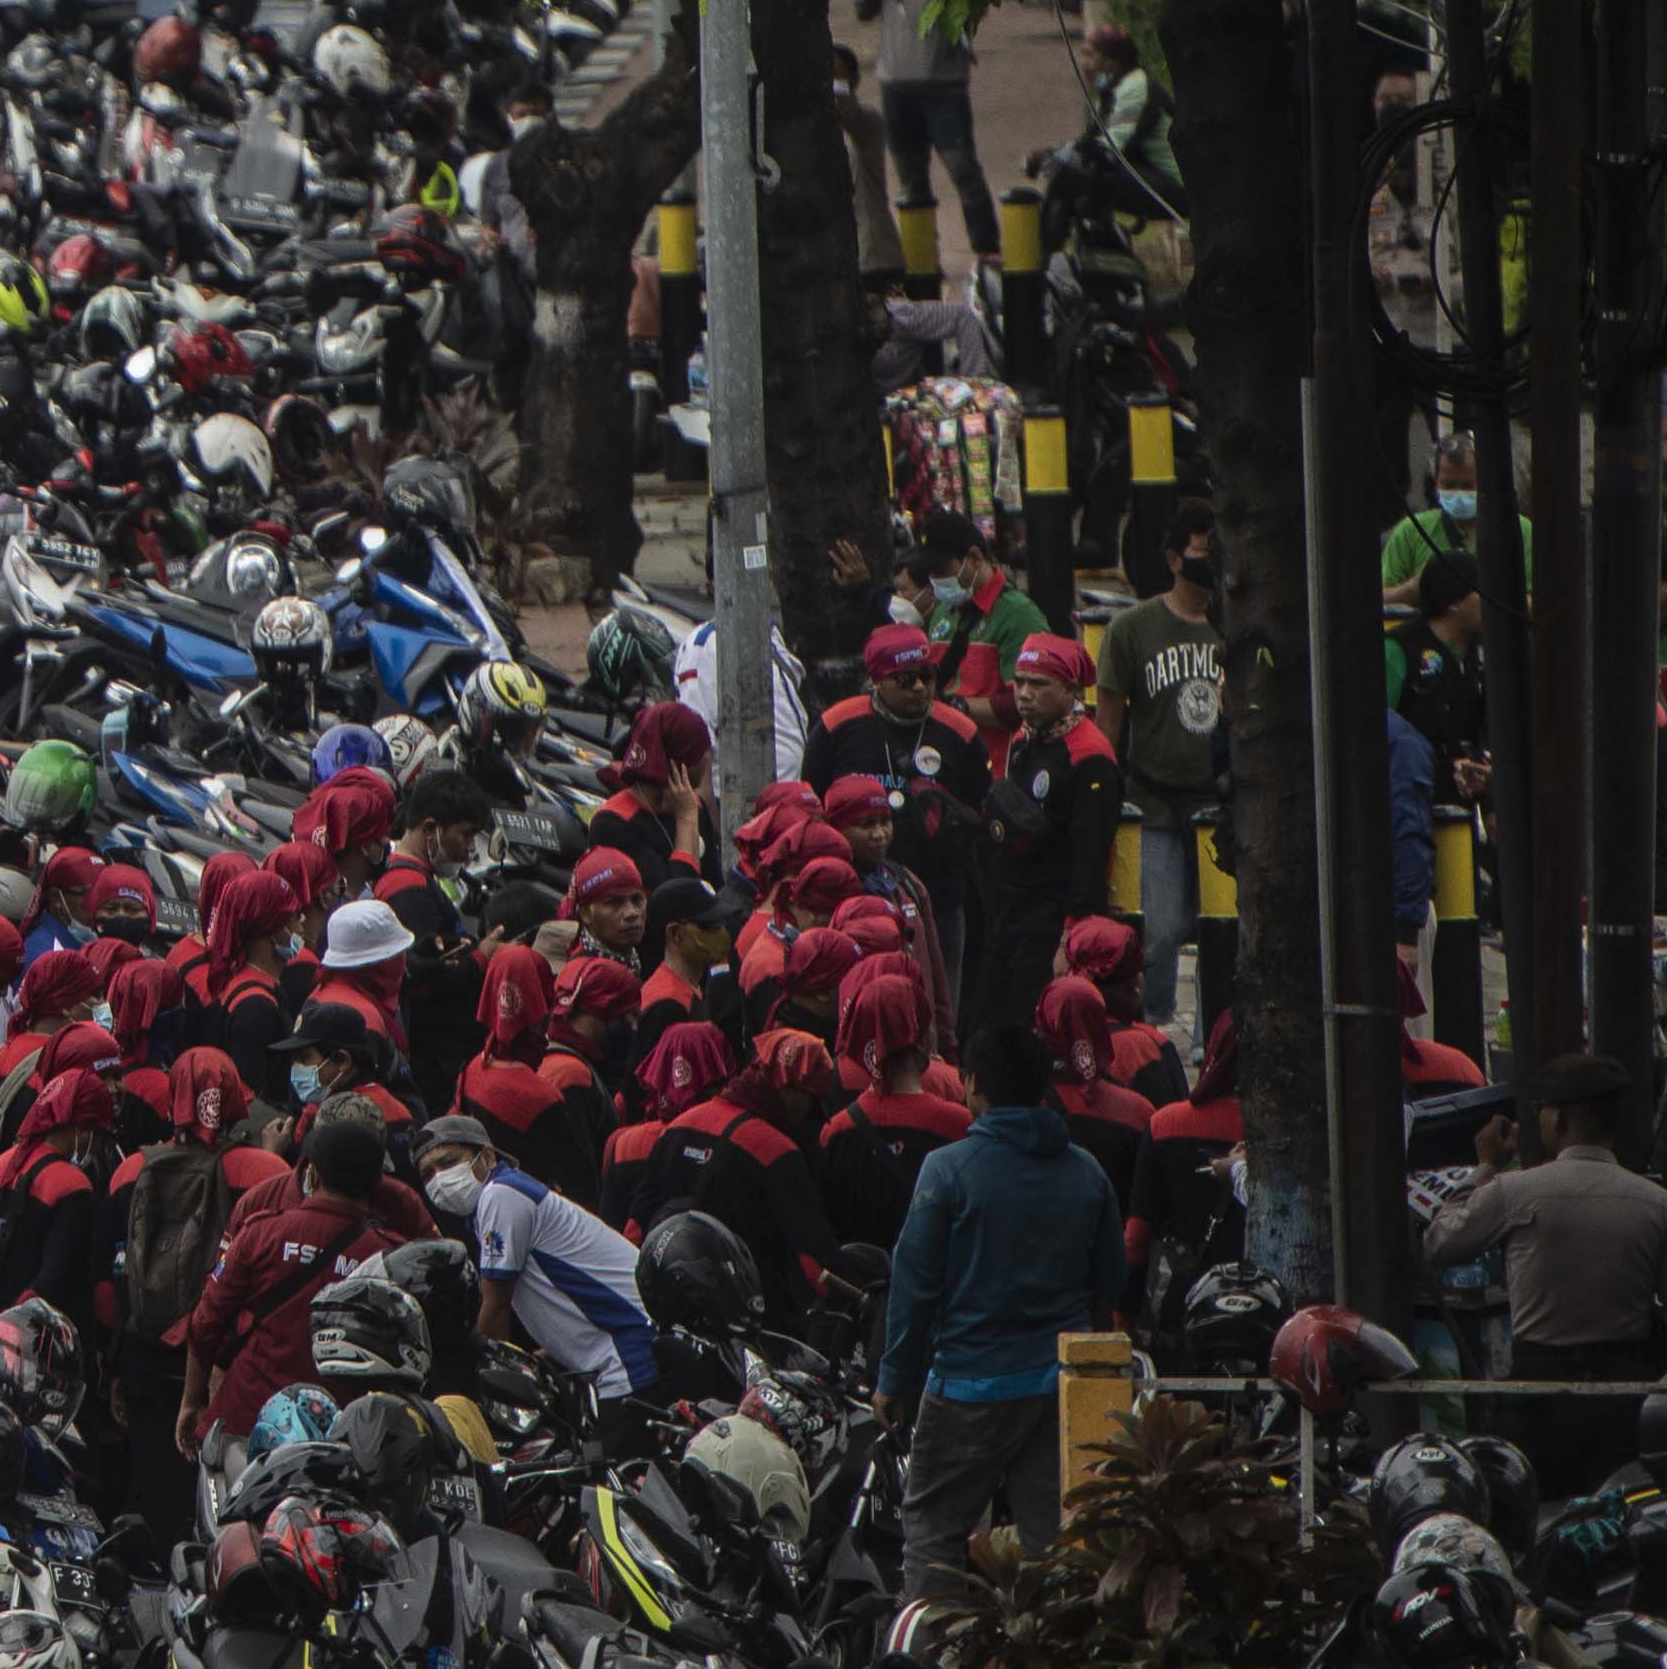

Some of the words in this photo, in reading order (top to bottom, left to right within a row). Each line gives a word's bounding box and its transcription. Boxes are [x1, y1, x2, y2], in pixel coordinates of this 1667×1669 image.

[283, 1242, 360, 1276] FSM
[53, 1567, 65, 1584] F
[1402, 1581, 1439, 1619] ADV
[1418, 1615, 1454, 1640] HONDA
